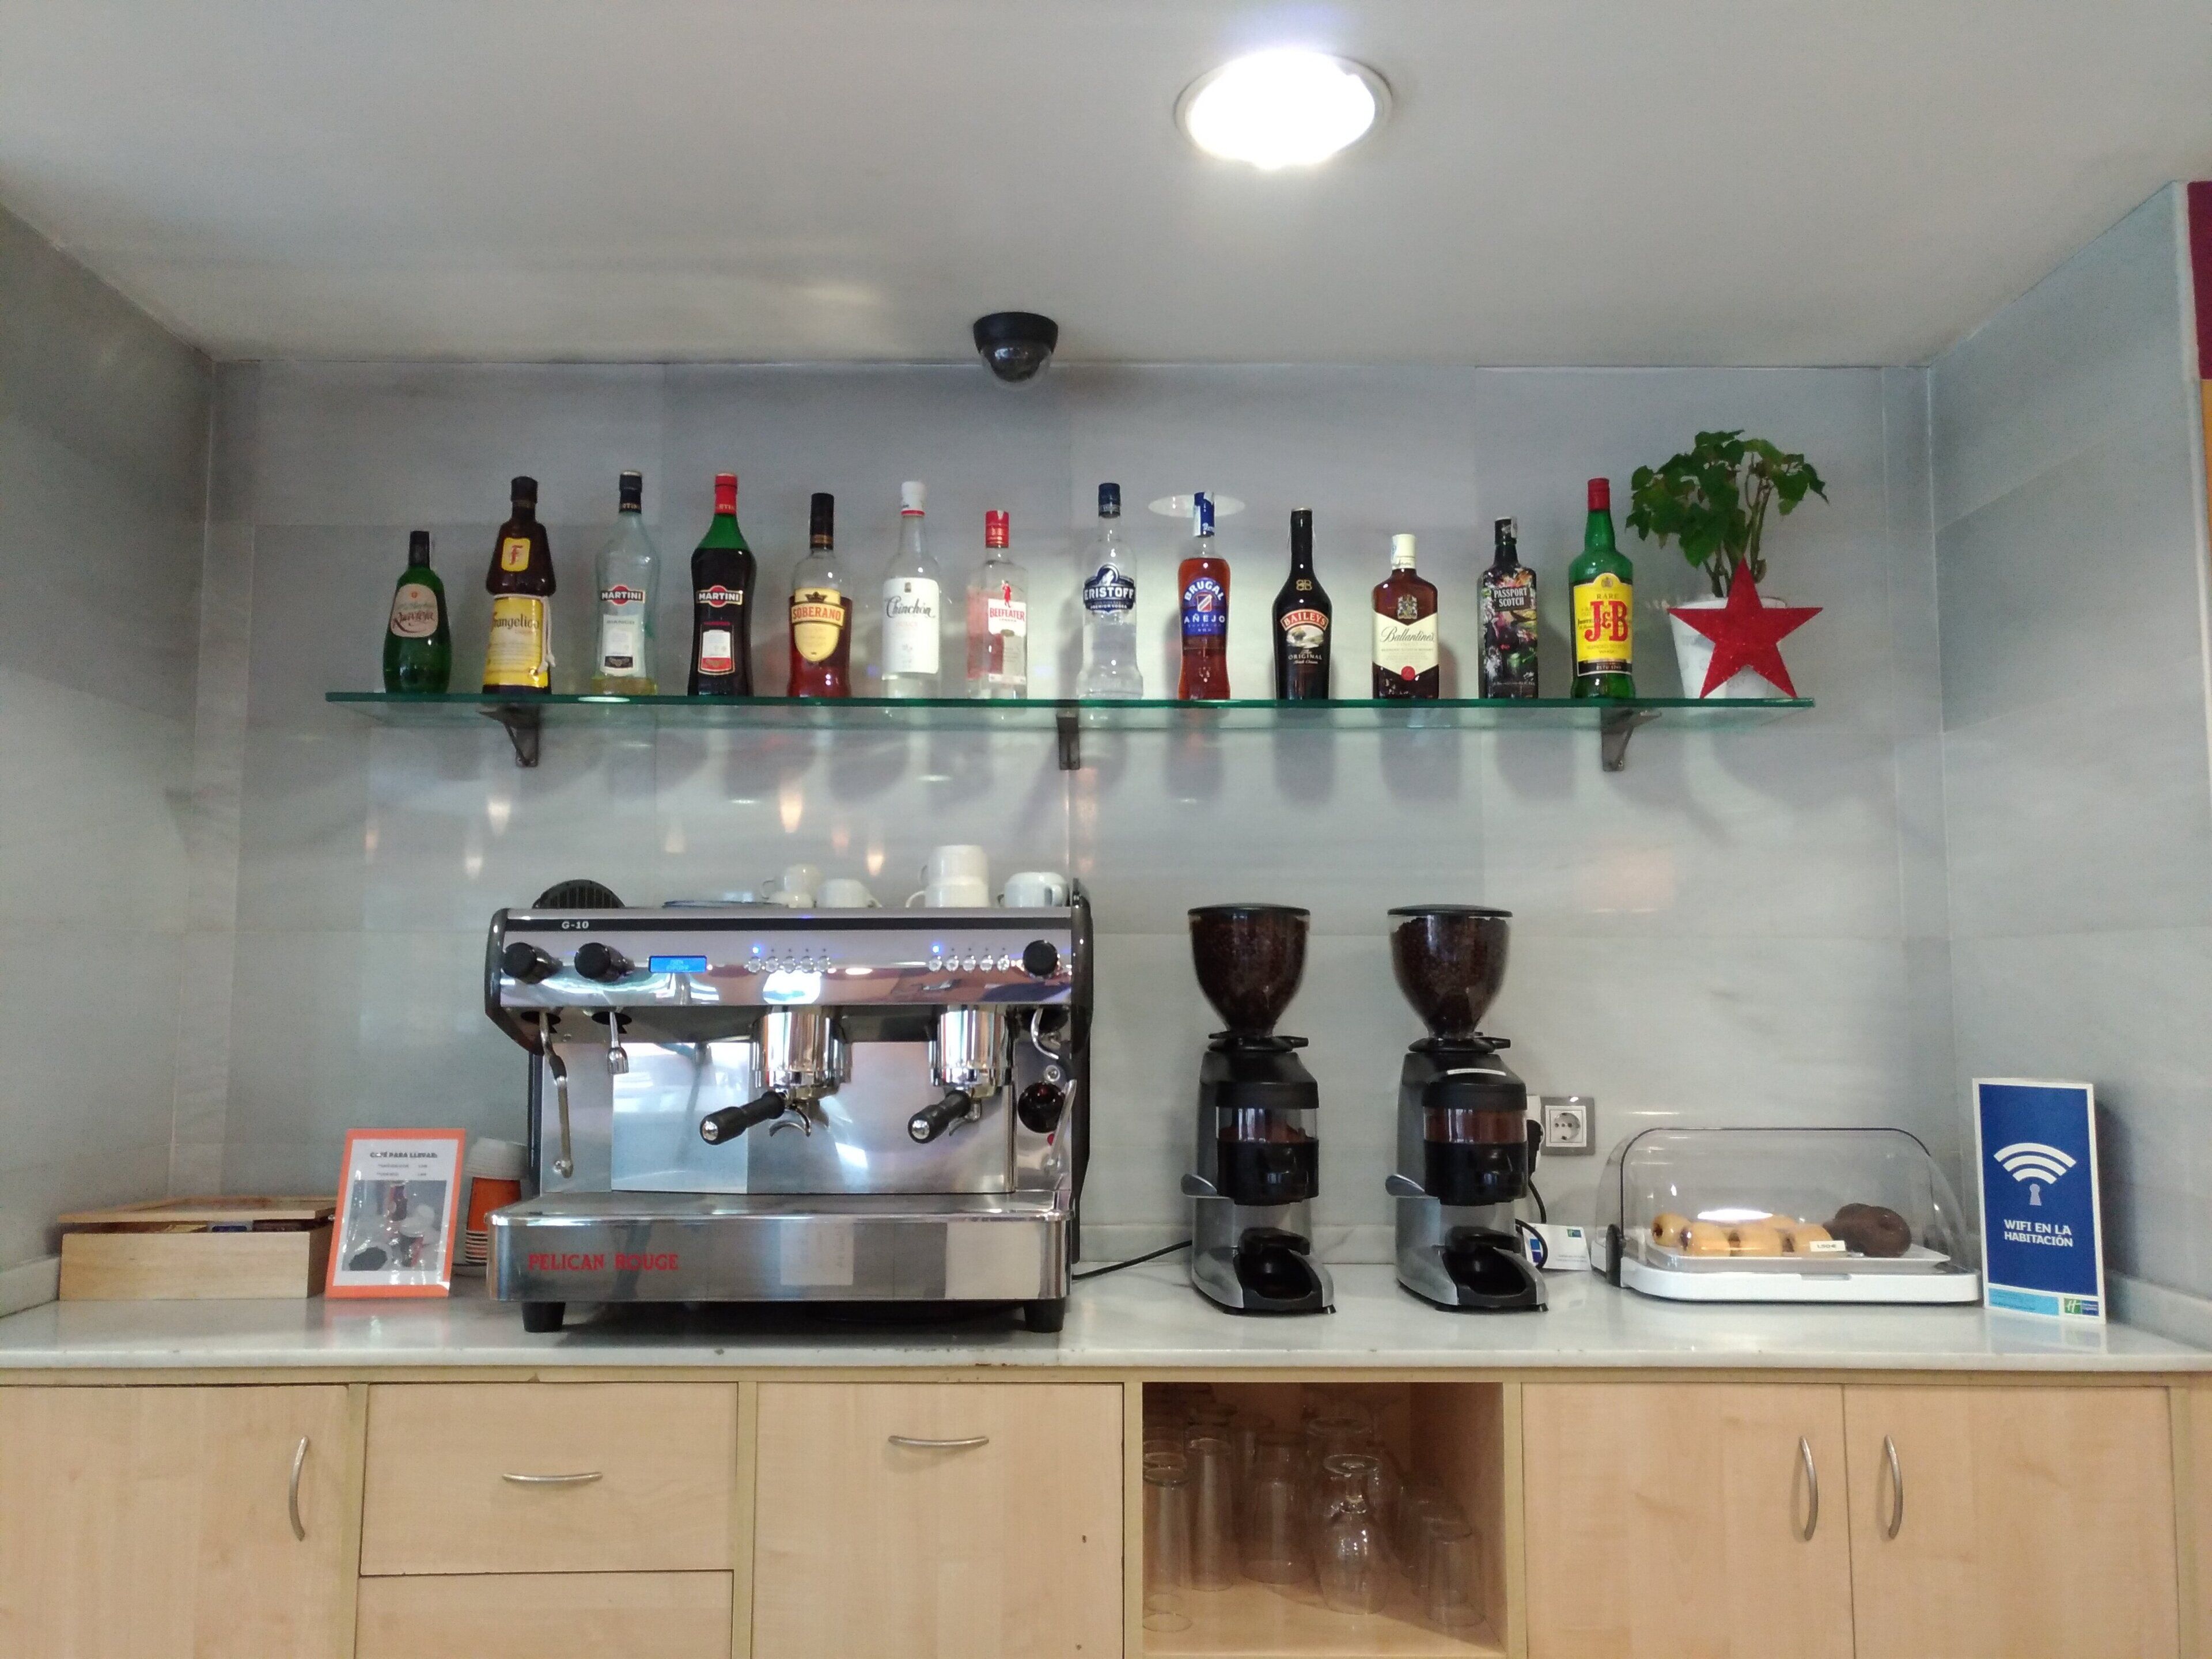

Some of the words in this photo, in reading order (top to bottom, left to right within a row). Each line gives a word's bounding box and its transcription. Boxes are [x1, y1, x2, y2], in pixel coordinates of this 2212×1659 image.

[601, 592, 642, 600] MARTINI
[699, 592, 739, 601] MARTINI
[1084, 587, 1134, 600] ERISTOFF
[1184, 581, 1224, 601] BRUGAL
[1494, 588, 1527, 599] PASSPORT
[1499, 597, 1524, 607] SCOTCH
[793, 606, 842, 622] SOBERANO
[990, 607, 1025, 622] BEEFEATER
[1184, 613, 1225, 624] AÑEJO
[1283, 612, 1326, 626] BAILEYS
[1584, 600, 1628, 642] J&B
[561, 921, 589, 929] G-10
[2003, 1219, 2031, 1232] WIFI
[2035, 1222, 2051, 1233] EN
[2055, 1225, 2072, 1236] LA
[2004, 1231, 2073, 1247] HABITACIÓN
[528, 1253, 604, 1271] PELICAN
[614, 1253, 679, 1271] ROUGE
